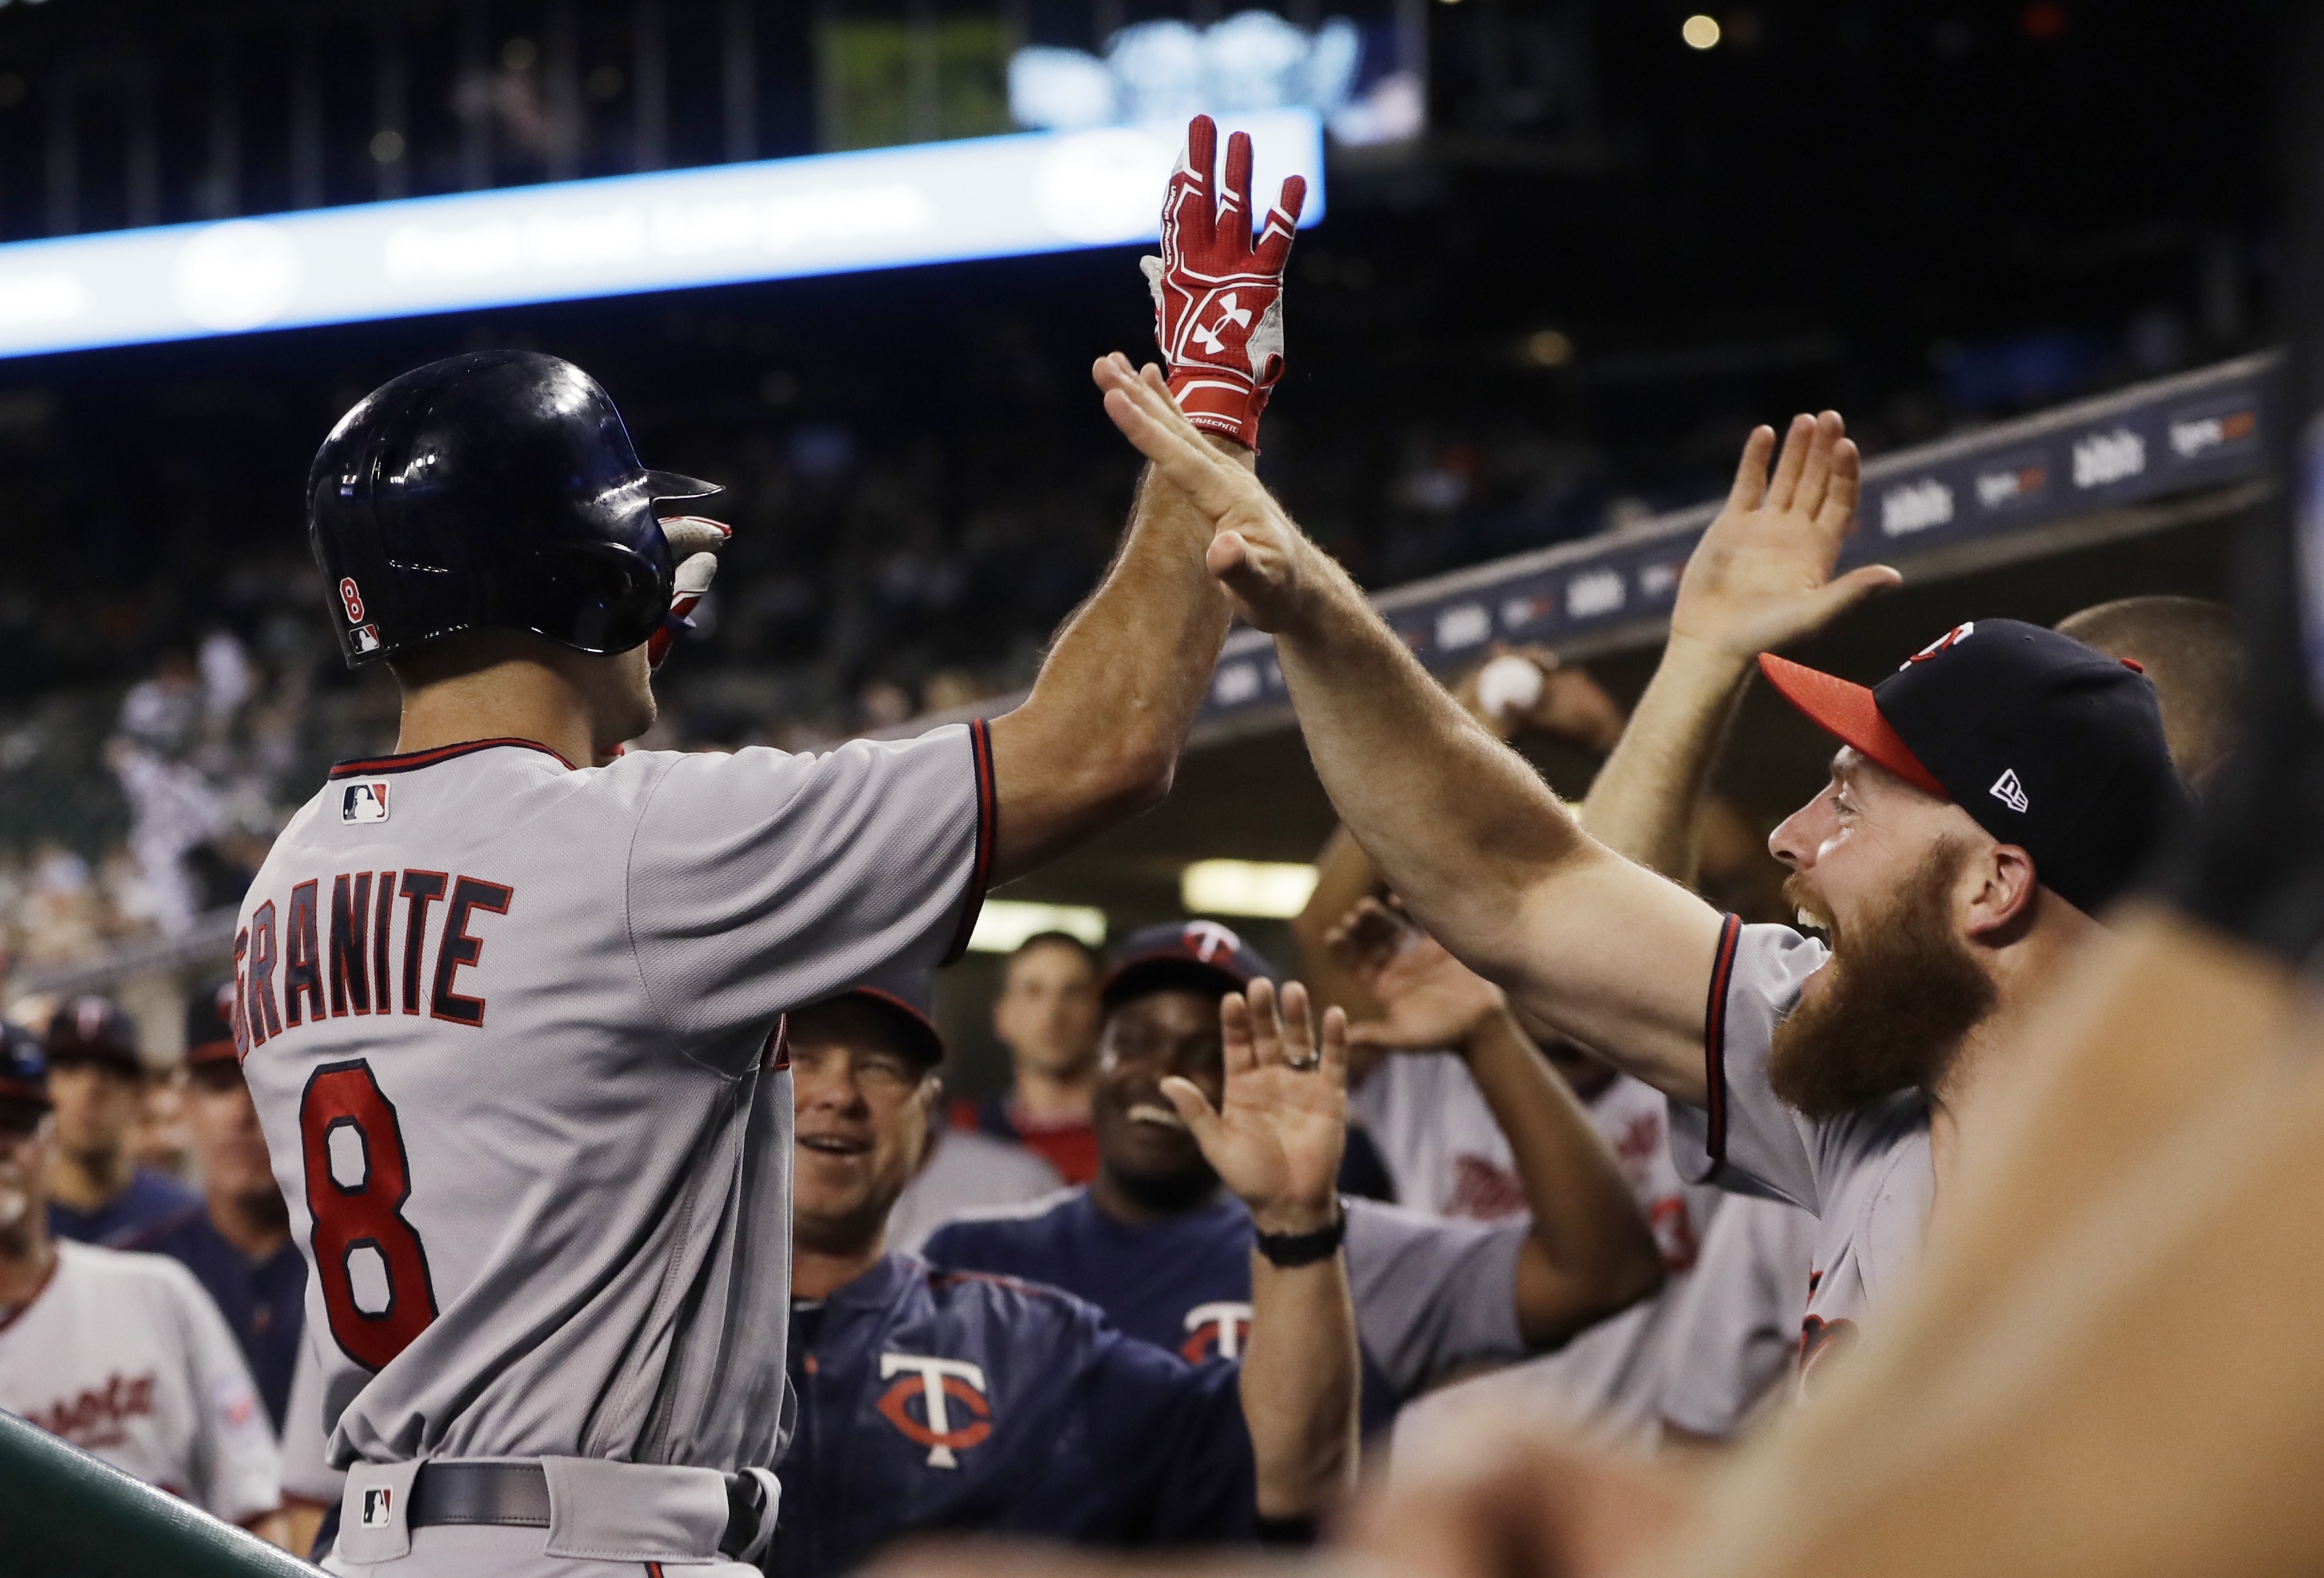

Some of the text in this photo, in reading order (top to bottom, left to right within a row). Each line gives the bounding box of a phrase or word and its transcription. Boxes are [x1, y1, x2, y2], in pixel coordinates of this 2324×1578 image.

[1164, 185, 1177, 220] UNDER
[340, 577, 365, 623] 8
[300, 1058, 439, 1374] 8
